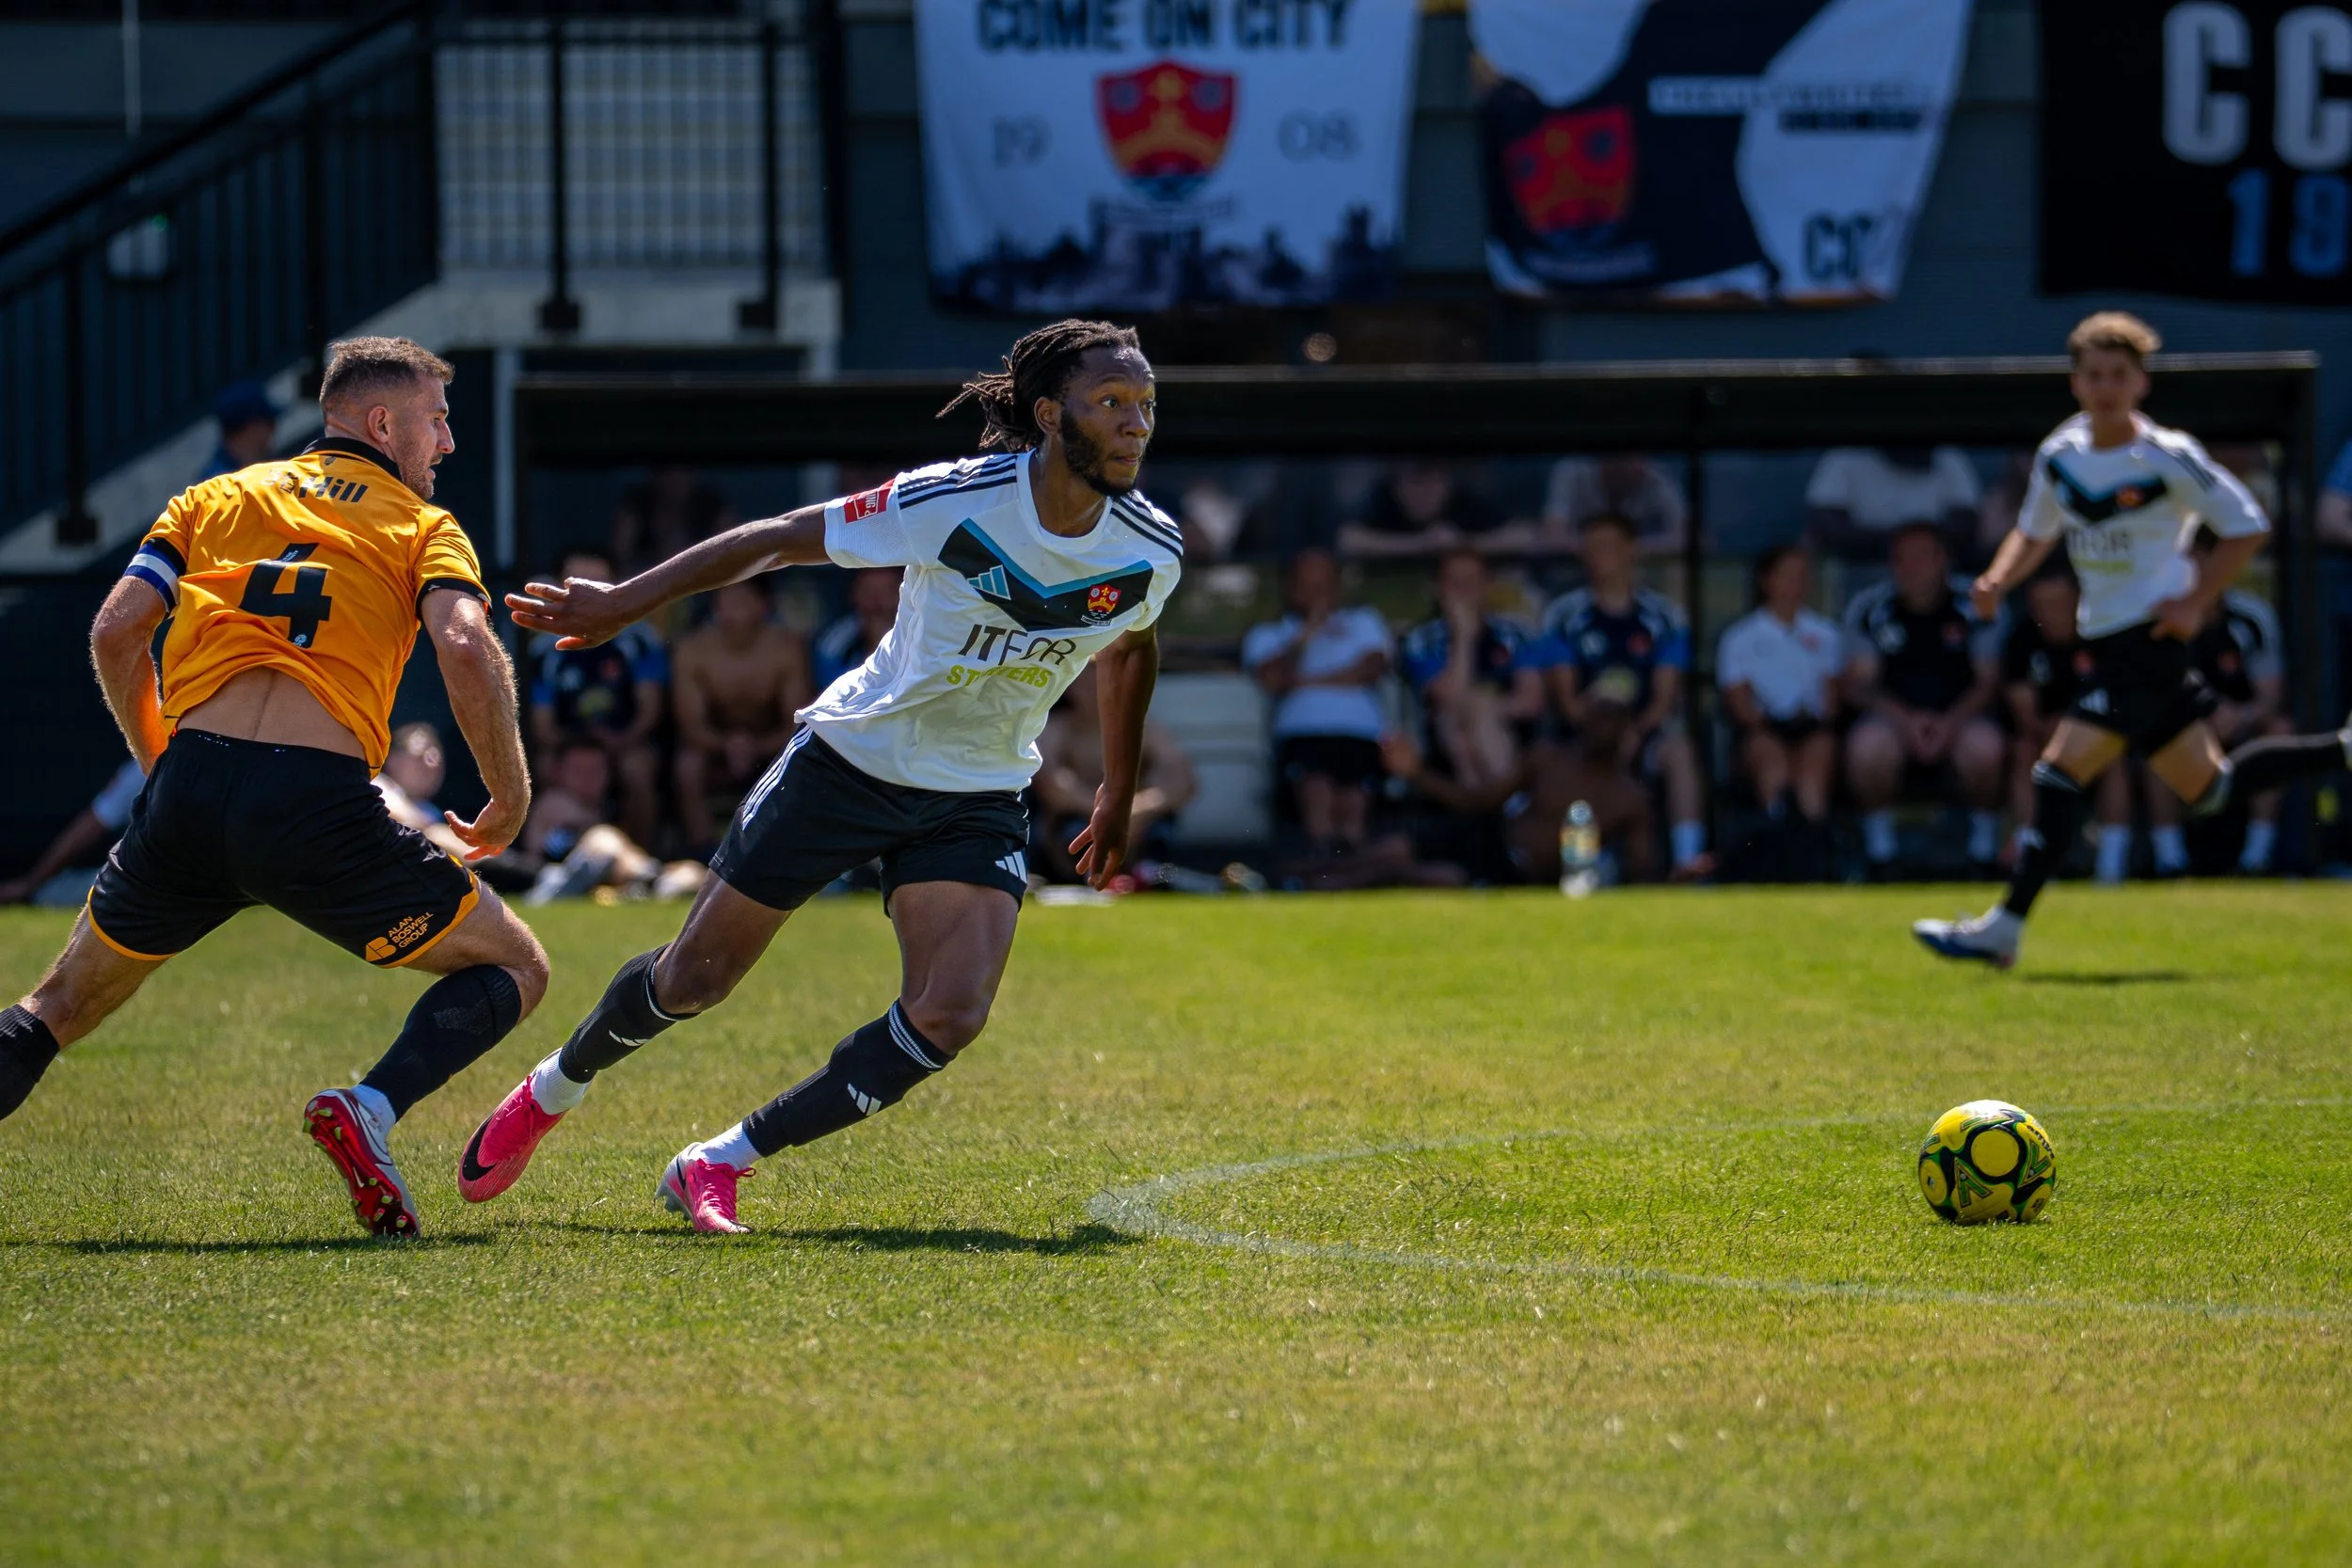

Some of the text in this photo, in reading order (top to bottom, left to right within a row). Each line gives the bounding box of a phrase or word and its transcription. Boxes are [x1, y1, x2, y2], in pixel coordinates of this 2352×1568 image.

[976, 0, 1352, 51] COME ON CITY
[238, 542, 332, 649] 4
[388, 916, 413, 938] ALAN
[391, 911, 434, 943] BOSWELL
[398, 923, 428, 948] GROUP
